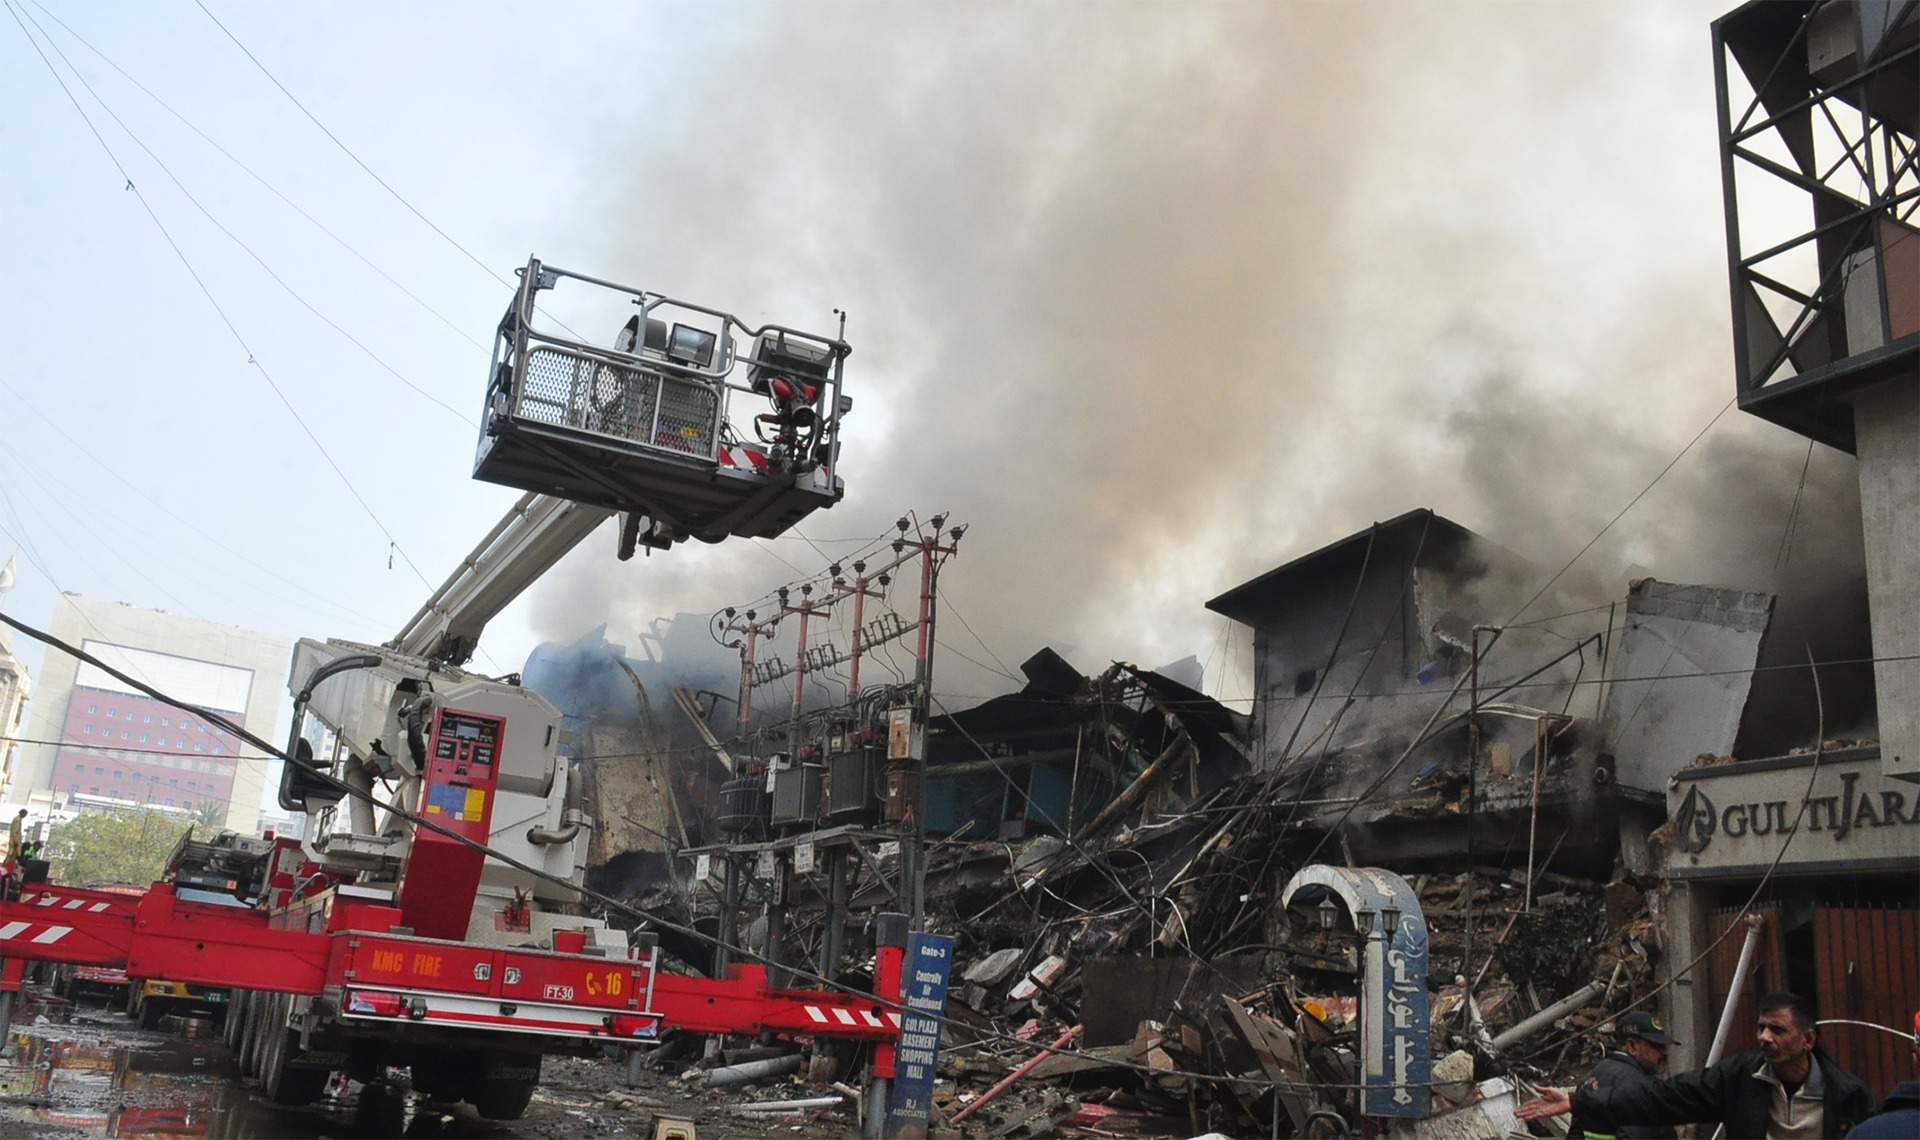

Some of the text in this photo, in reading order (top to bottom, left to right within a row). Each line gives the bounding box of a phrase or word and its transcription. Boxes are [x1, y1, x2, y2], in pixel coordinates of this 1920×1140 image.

[1721, 800, 1796, 838] GUL
[921, 945, 945, 958] Gate-3
[372, 950, 442, 977] KMC FIRE
[605, 972, 622, 996] 16
[915, 969, 942, 985] Centrally
[545, 986, 574, 1000] FT-30
[922, 984, 932, 996] Air
[907, 995, 943, 1011] Conditioned
[905, 1018, 938, 1034] GUL PLAZA
[1622, 1024, 1639, 1034] FIRE
[902, 1033, 937, 1050] BASEMENT
[900, 1047, 934, 1065] SHOPPING
[906, 1065, 924, 1079] MALL
[906, 1098, 917, 1110] RJ
[892, 1107, 927, 1119] ASSOCIATES
